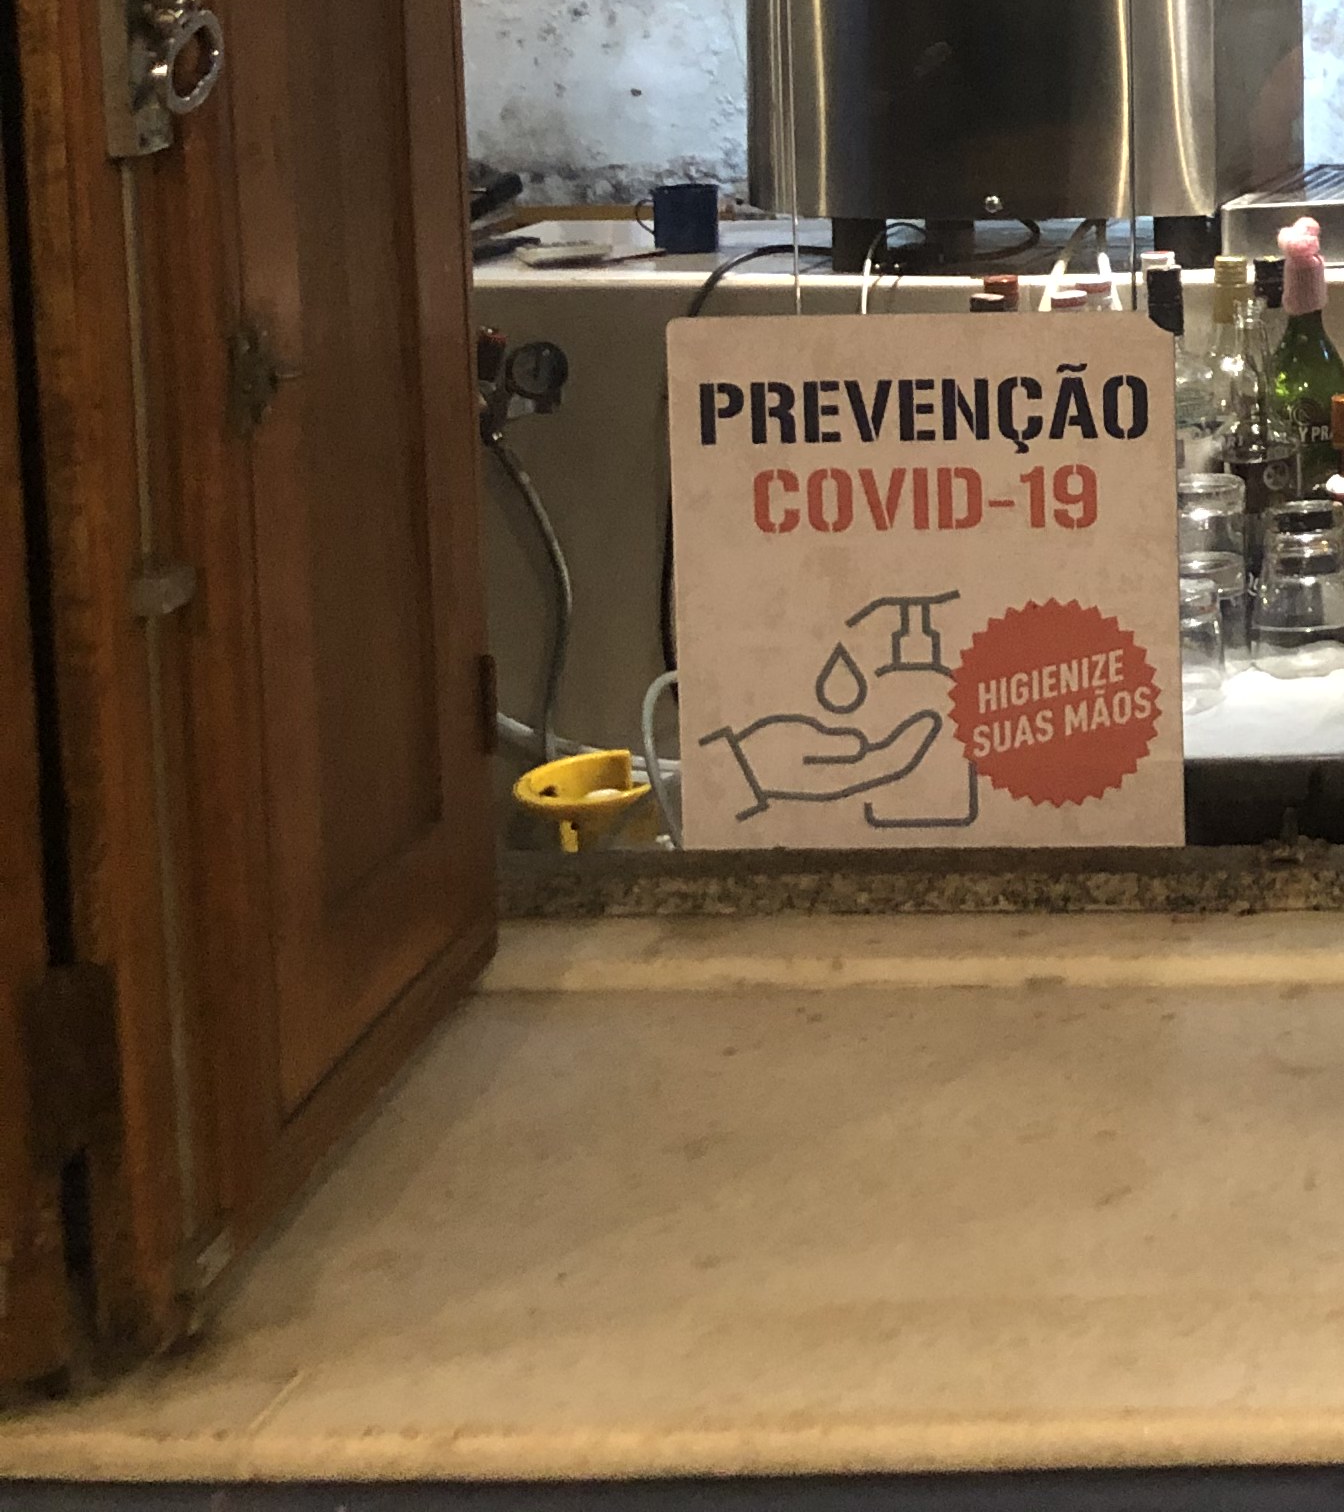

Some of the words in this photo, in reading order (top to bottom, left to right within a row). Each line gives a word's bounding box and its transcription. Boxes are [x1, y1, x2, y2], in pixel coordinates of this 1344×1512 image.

[699, 362, 1150, 454] PREVENÇÃO
[753, 463, 1099, 535] COVID-19
[976, 647, 1126, 715] HIGIENIZE
[972, 706, 1055, 760] SUAS
[1063, 685, 1154, 737] MÃOS
